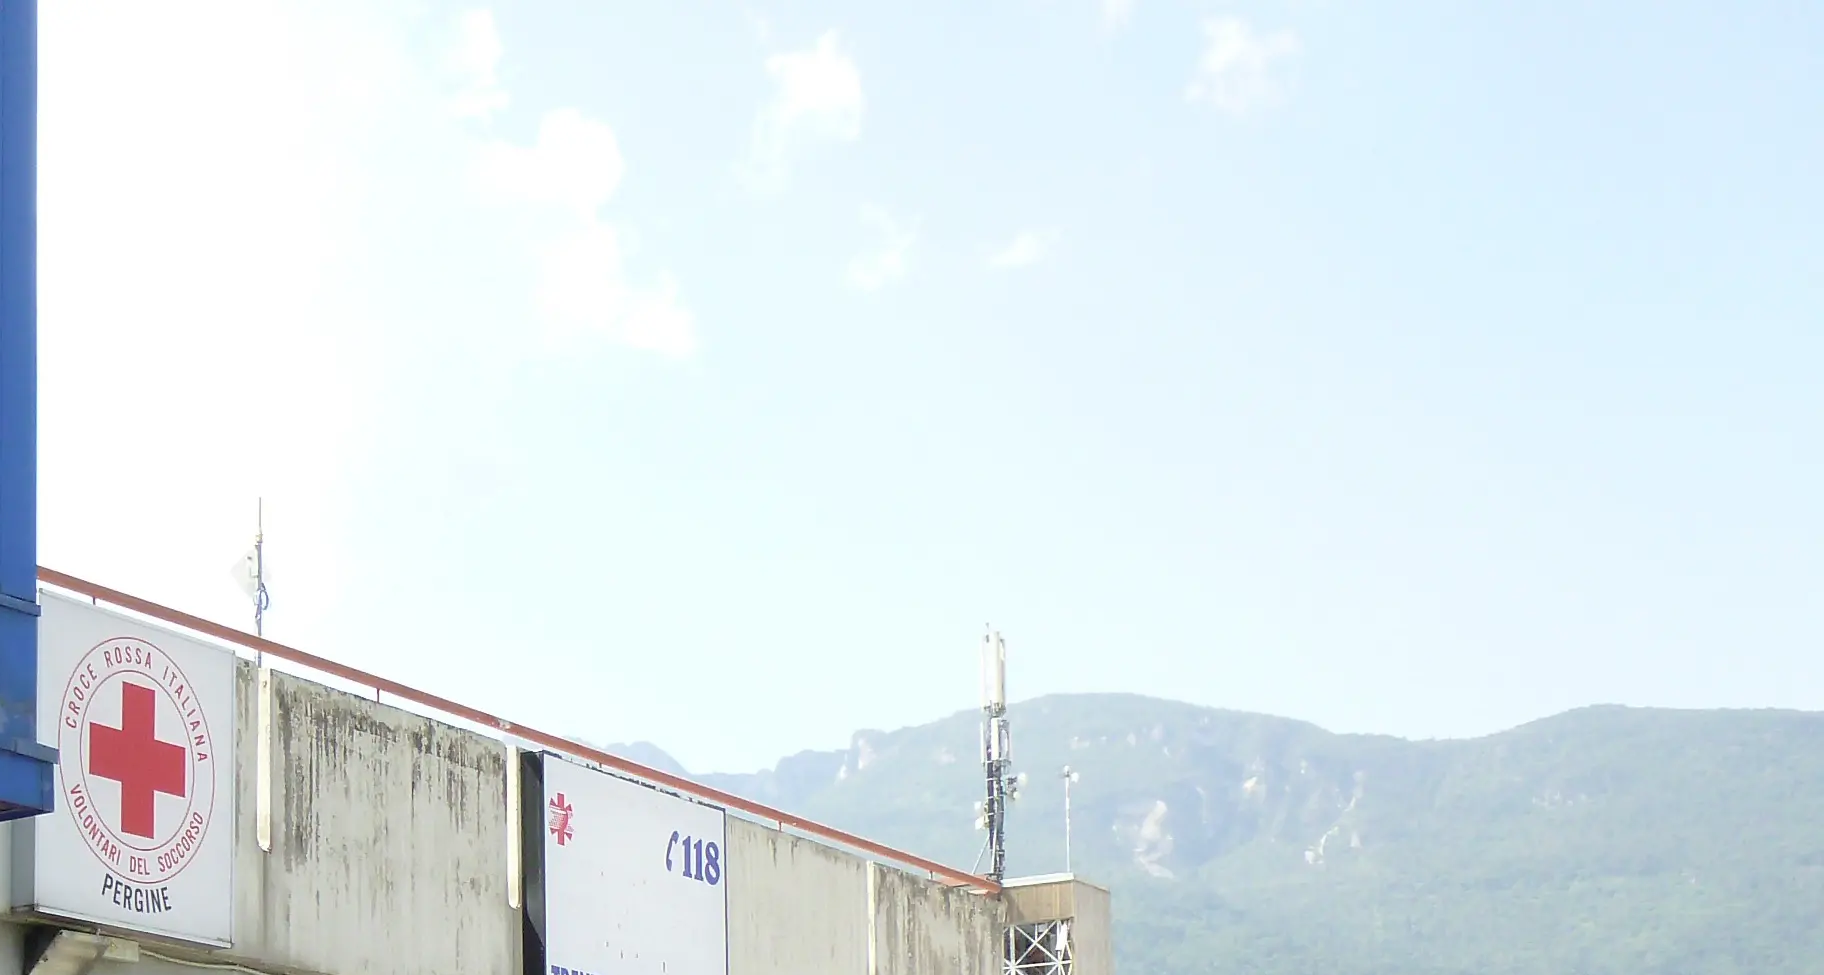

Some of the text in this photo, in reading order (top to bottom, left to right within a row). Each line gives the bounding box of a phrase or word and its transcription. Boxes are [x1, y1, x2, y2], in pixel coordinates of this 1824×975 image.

[65, 646, 208, 762] CROCE ROSSA ITALIANA
[70, 784, 204, 876] VOLONTARI DEL SOCCORSO
[682, 836, 721, 886] 118
[101, 873, 172, 914] PERGINE
